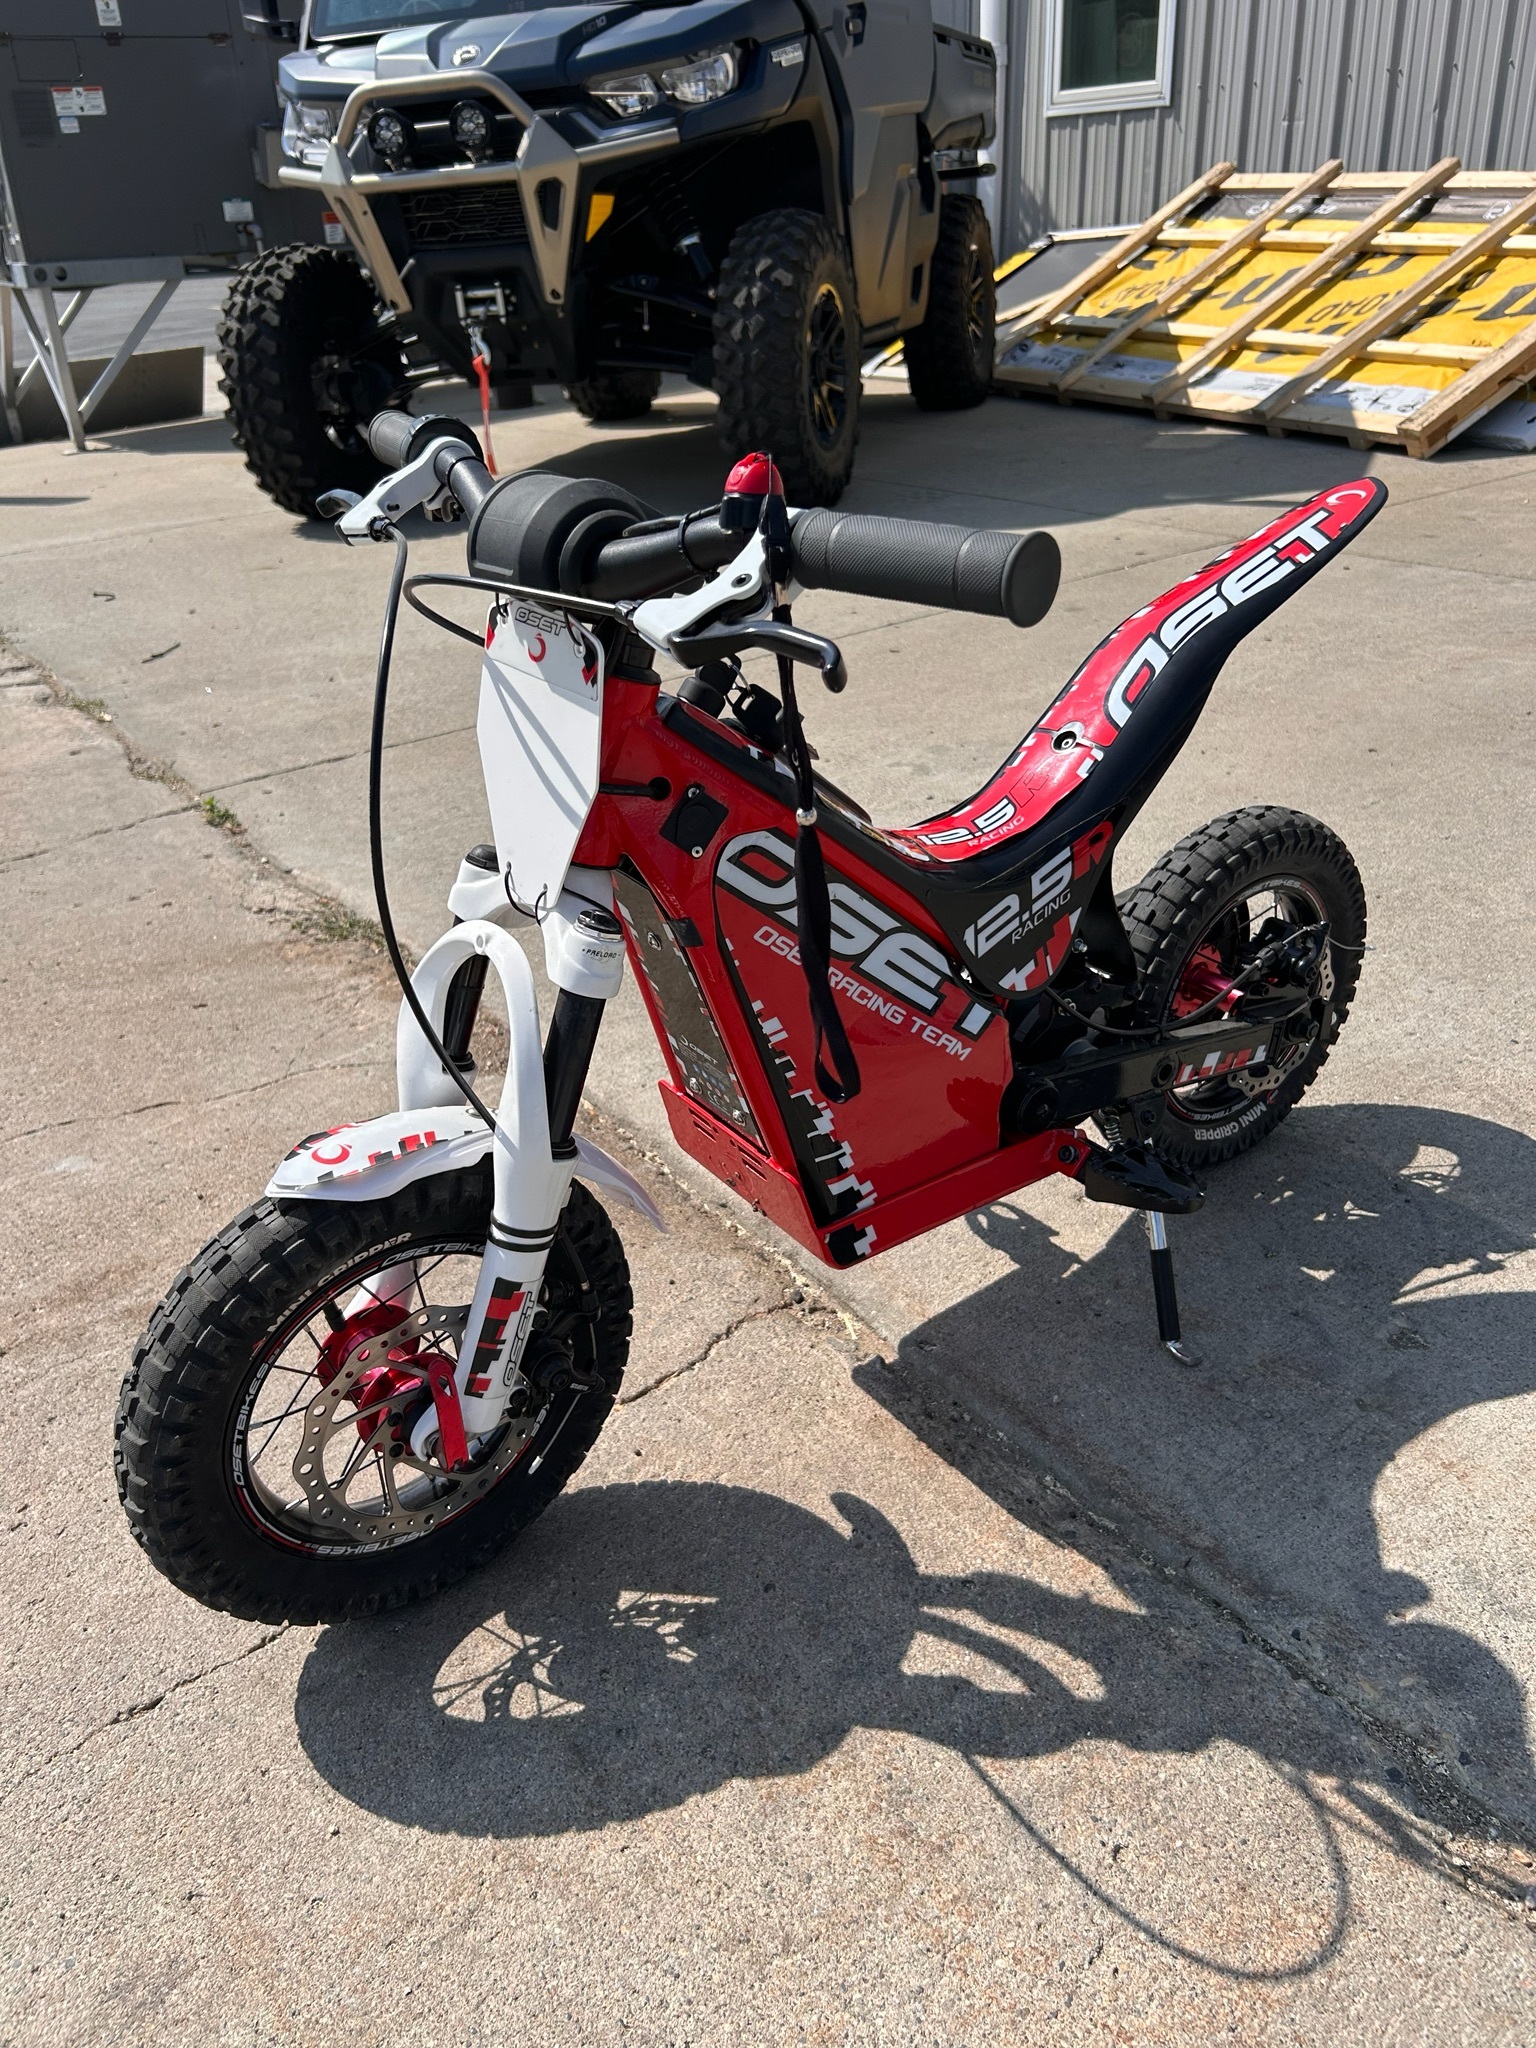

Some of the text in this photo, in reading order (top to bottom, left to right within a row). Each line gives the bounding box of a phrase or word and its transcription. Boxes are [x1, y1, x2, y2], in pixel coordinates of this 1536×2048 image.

[515, 606, 568, 636] OSET
[1107, 509, 1331, 728] OSET
[967, 815, 1025, 847] RACING
[716, 830, 996, 1037] OSET
[1011, 888, 1071, 945] RACING
[585, 948, 618, 959] PRELOAD
[753, 925, 973, 1062] OSE RACING TEAM
[689, 1043, 719, 1065] OSET
[1194, 1102, 1267, 1141] MINI GRIPPER
[232, 1362, 270, 1486] OSETBIKES
